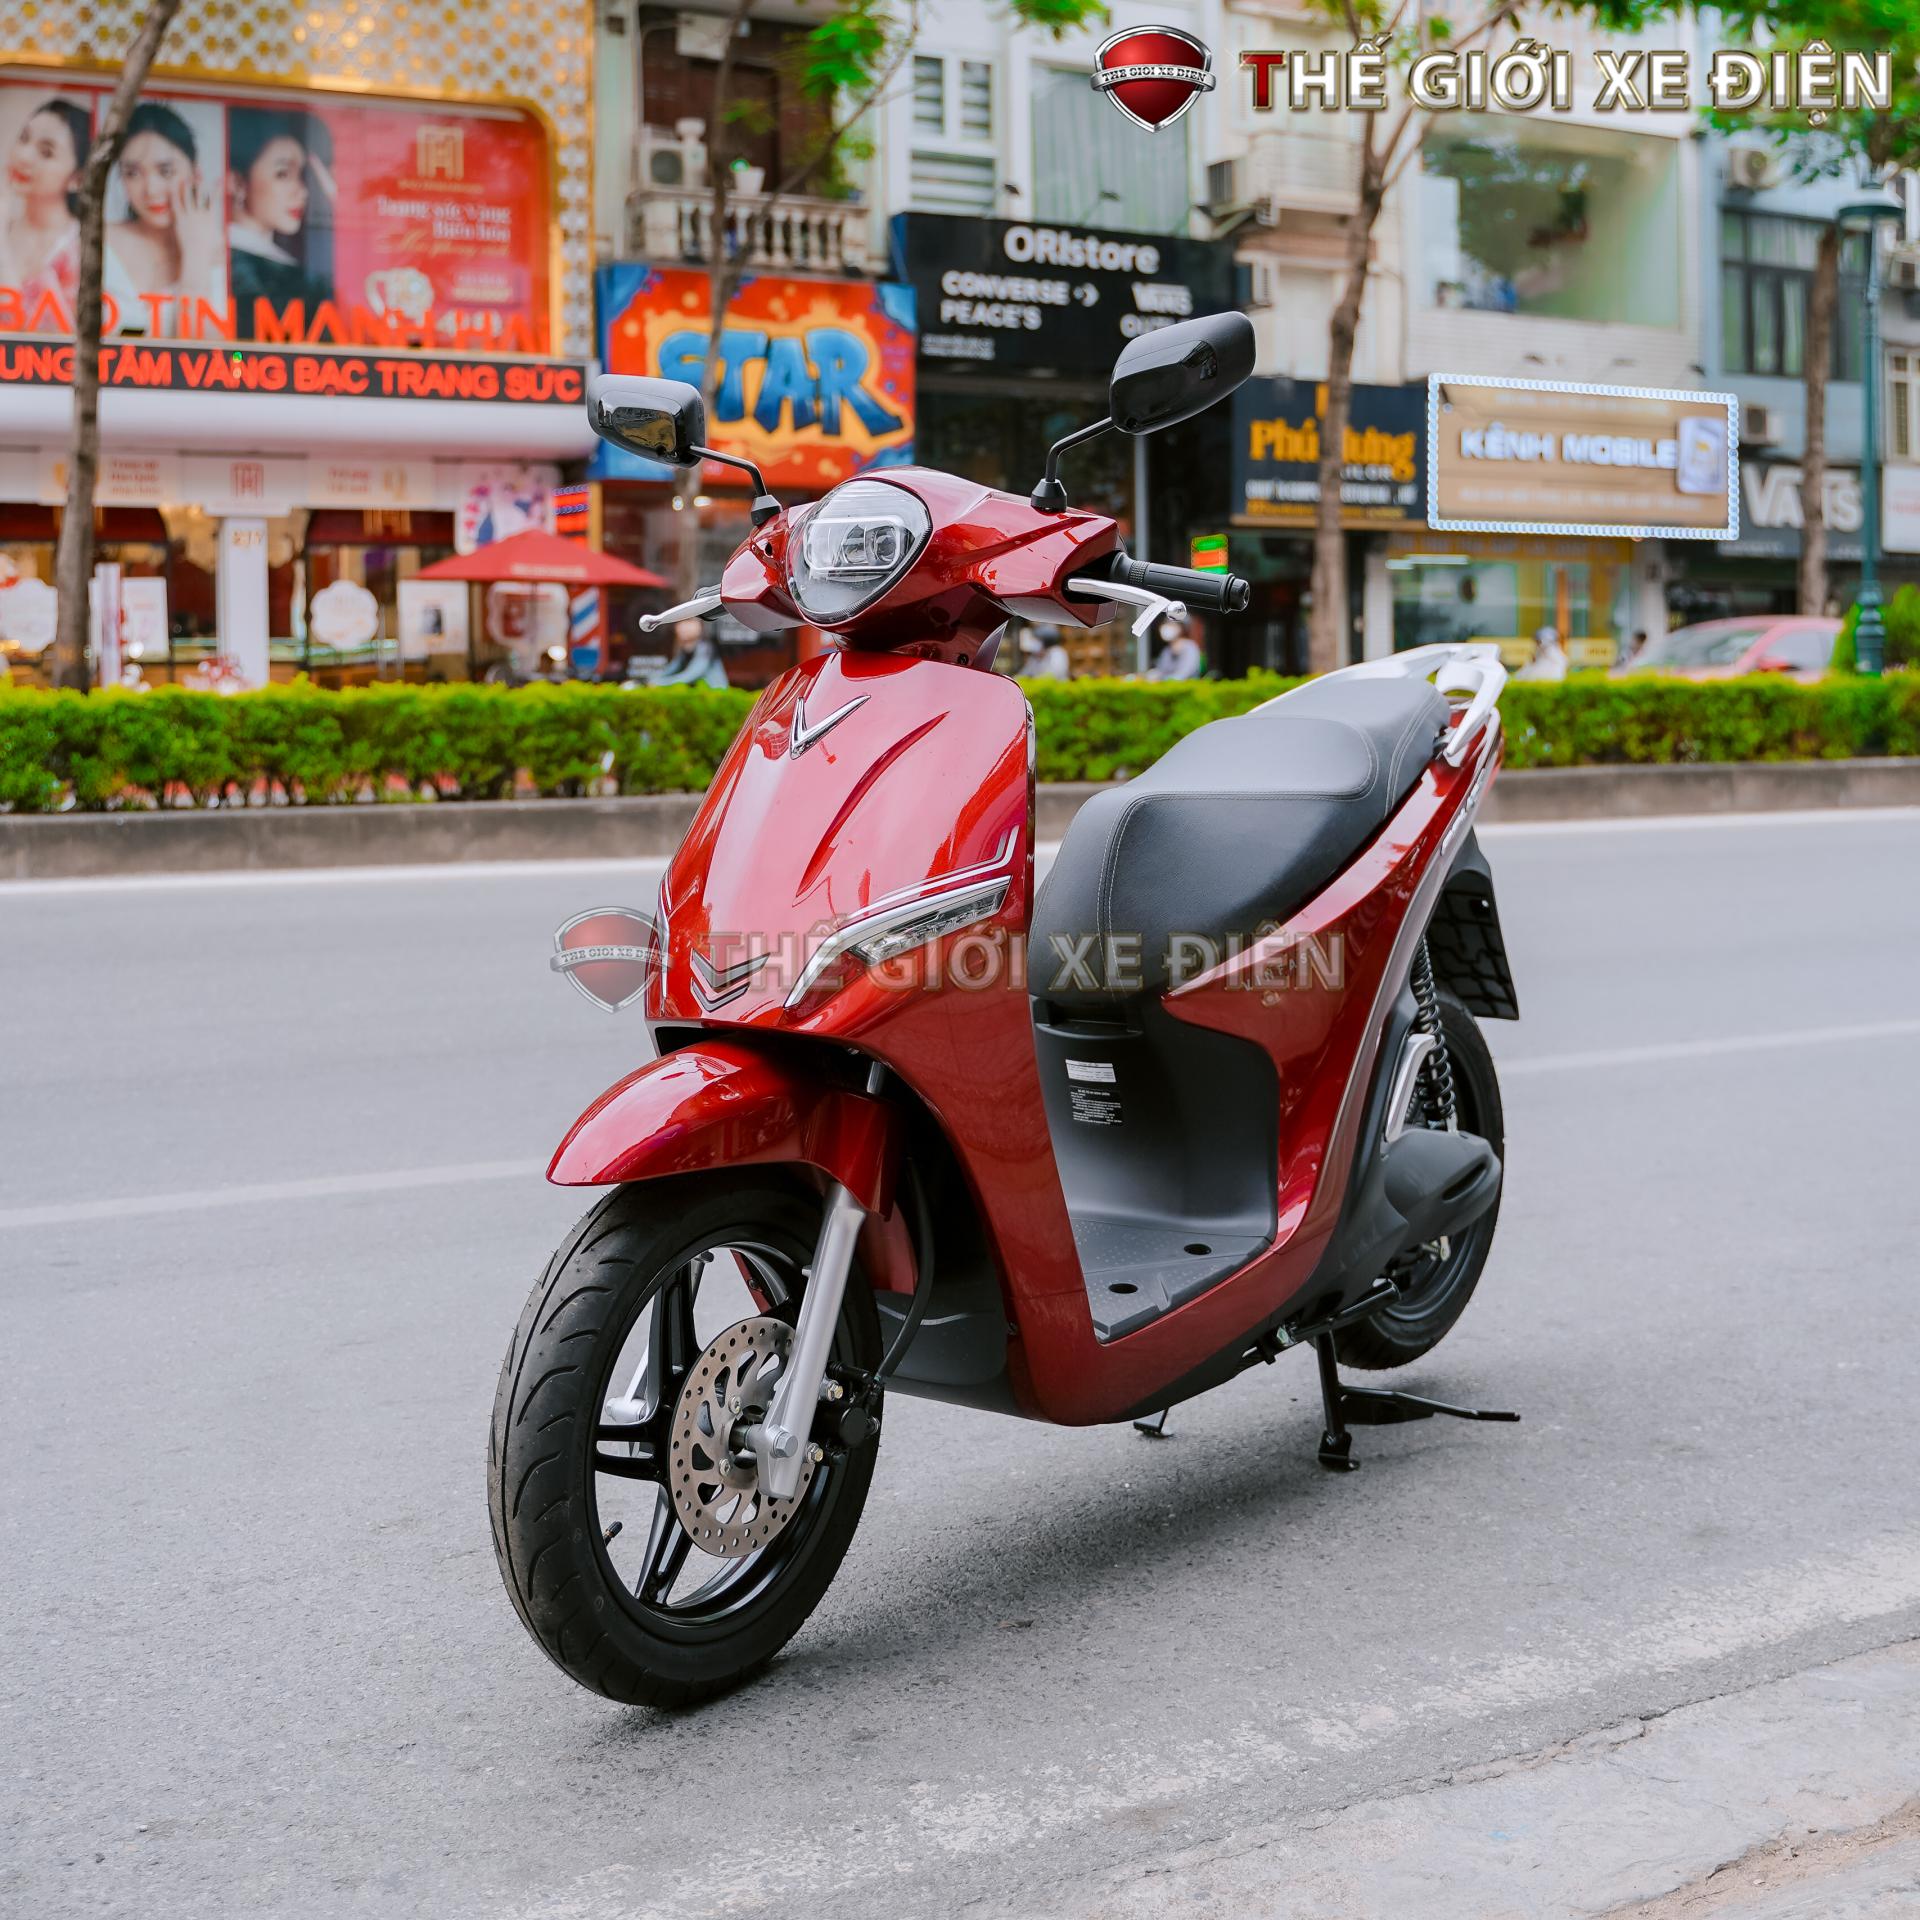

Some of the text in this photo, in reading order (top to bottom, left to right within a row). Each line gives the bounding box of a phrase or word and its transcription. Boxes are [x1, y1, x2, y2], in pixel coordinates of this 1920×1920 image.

[1003, 225, 1160, 274] ORIstore
[941, 270, 1071, 306] CONVERSE
[940, 299, 1042, 330] PEACE'S
[293, 357, 370, 397] BẠC
[375, 360, 500, 399] TRANG
[658, 328, 904, 437] STAR
[1250, 417, 1320, 462] Phú
[1460, 420, 1678, 470] KÊNH MOBILE
[1243, 947, 1319, 992] VINFAST
